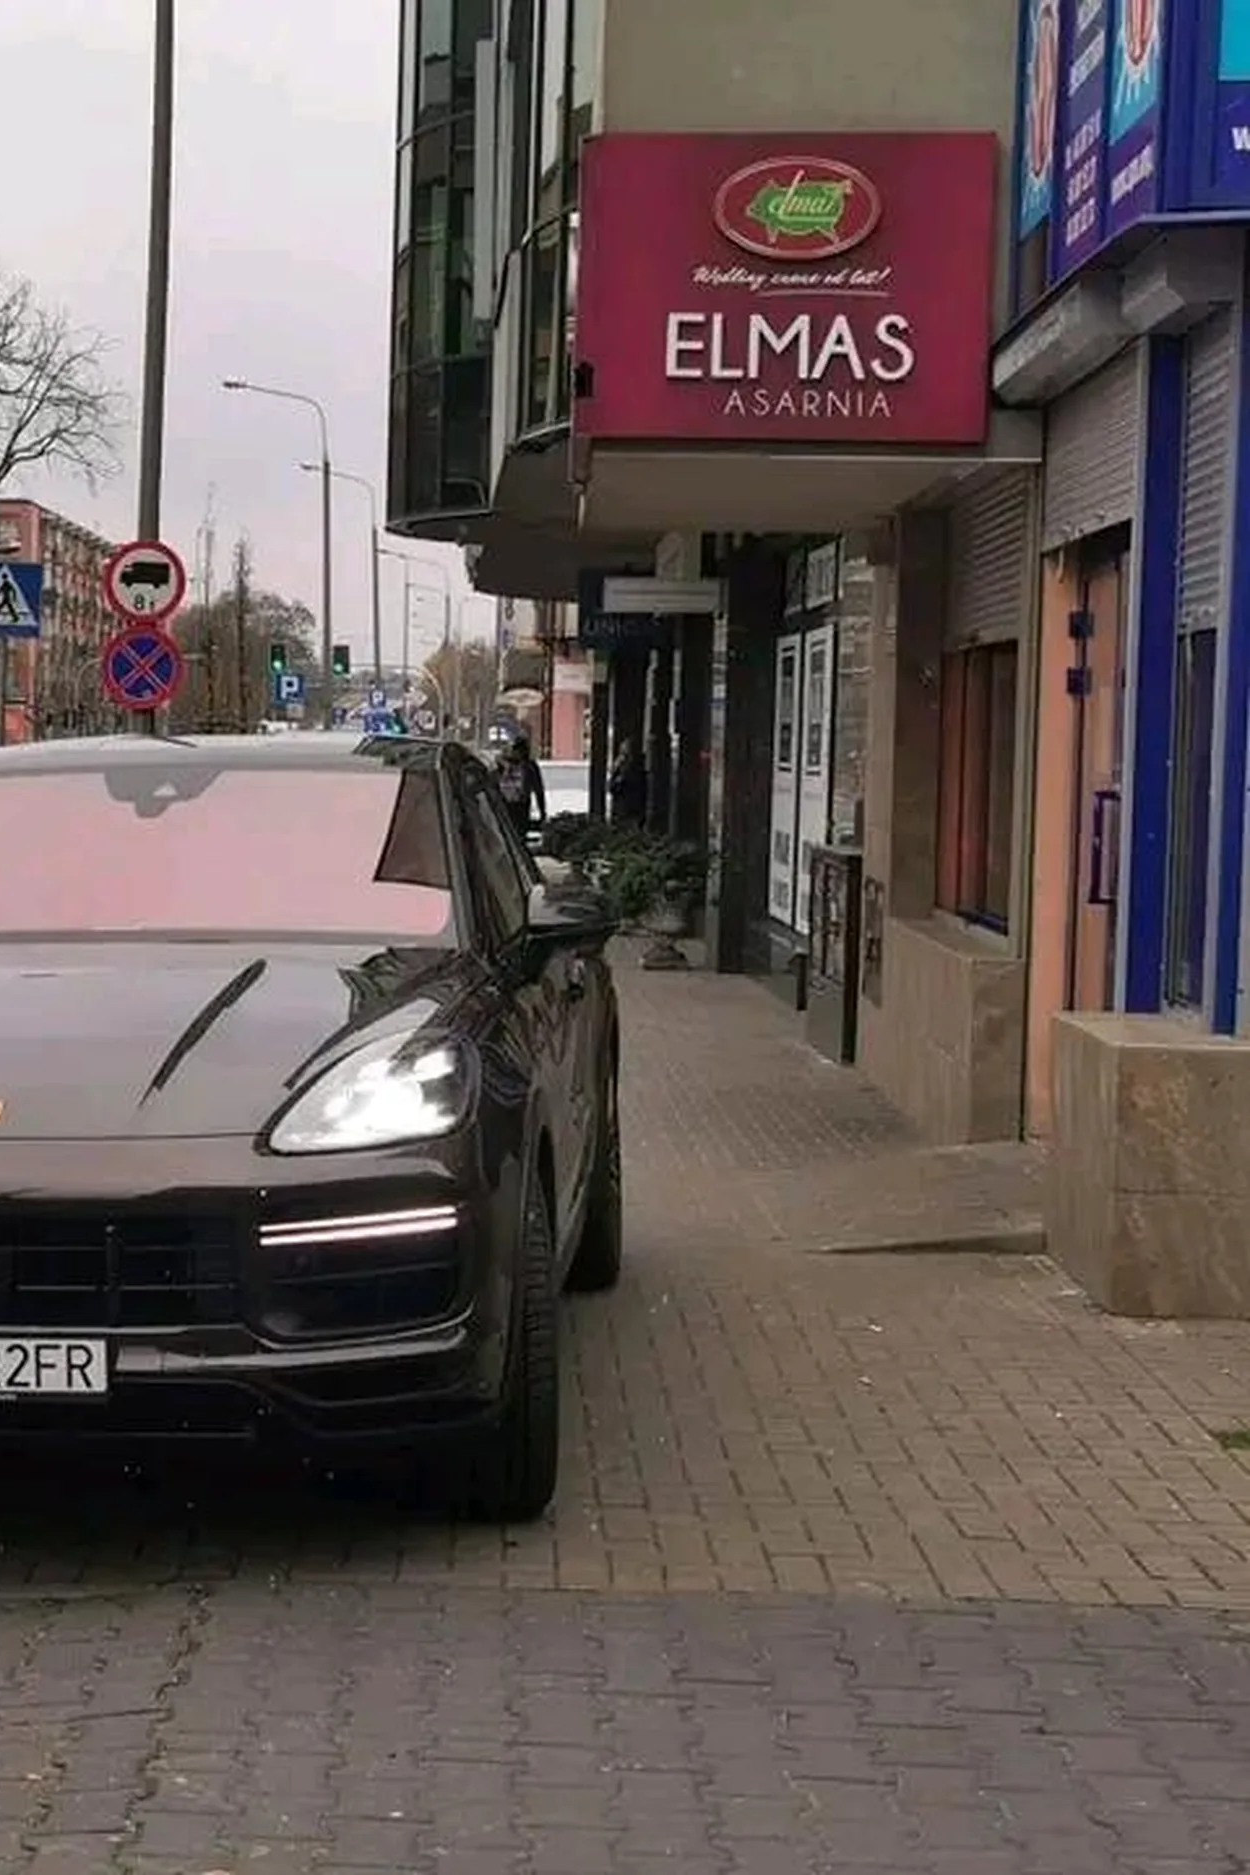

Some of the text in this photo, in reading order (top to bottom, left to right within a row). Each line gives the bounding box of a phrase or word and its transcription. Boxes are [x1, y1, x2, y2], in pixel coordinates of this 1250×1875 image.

[665, 312, 915, 381] ELMAS
[723, 389, 892, 418] ASARNIA
[280, 675, 299, 699] P
